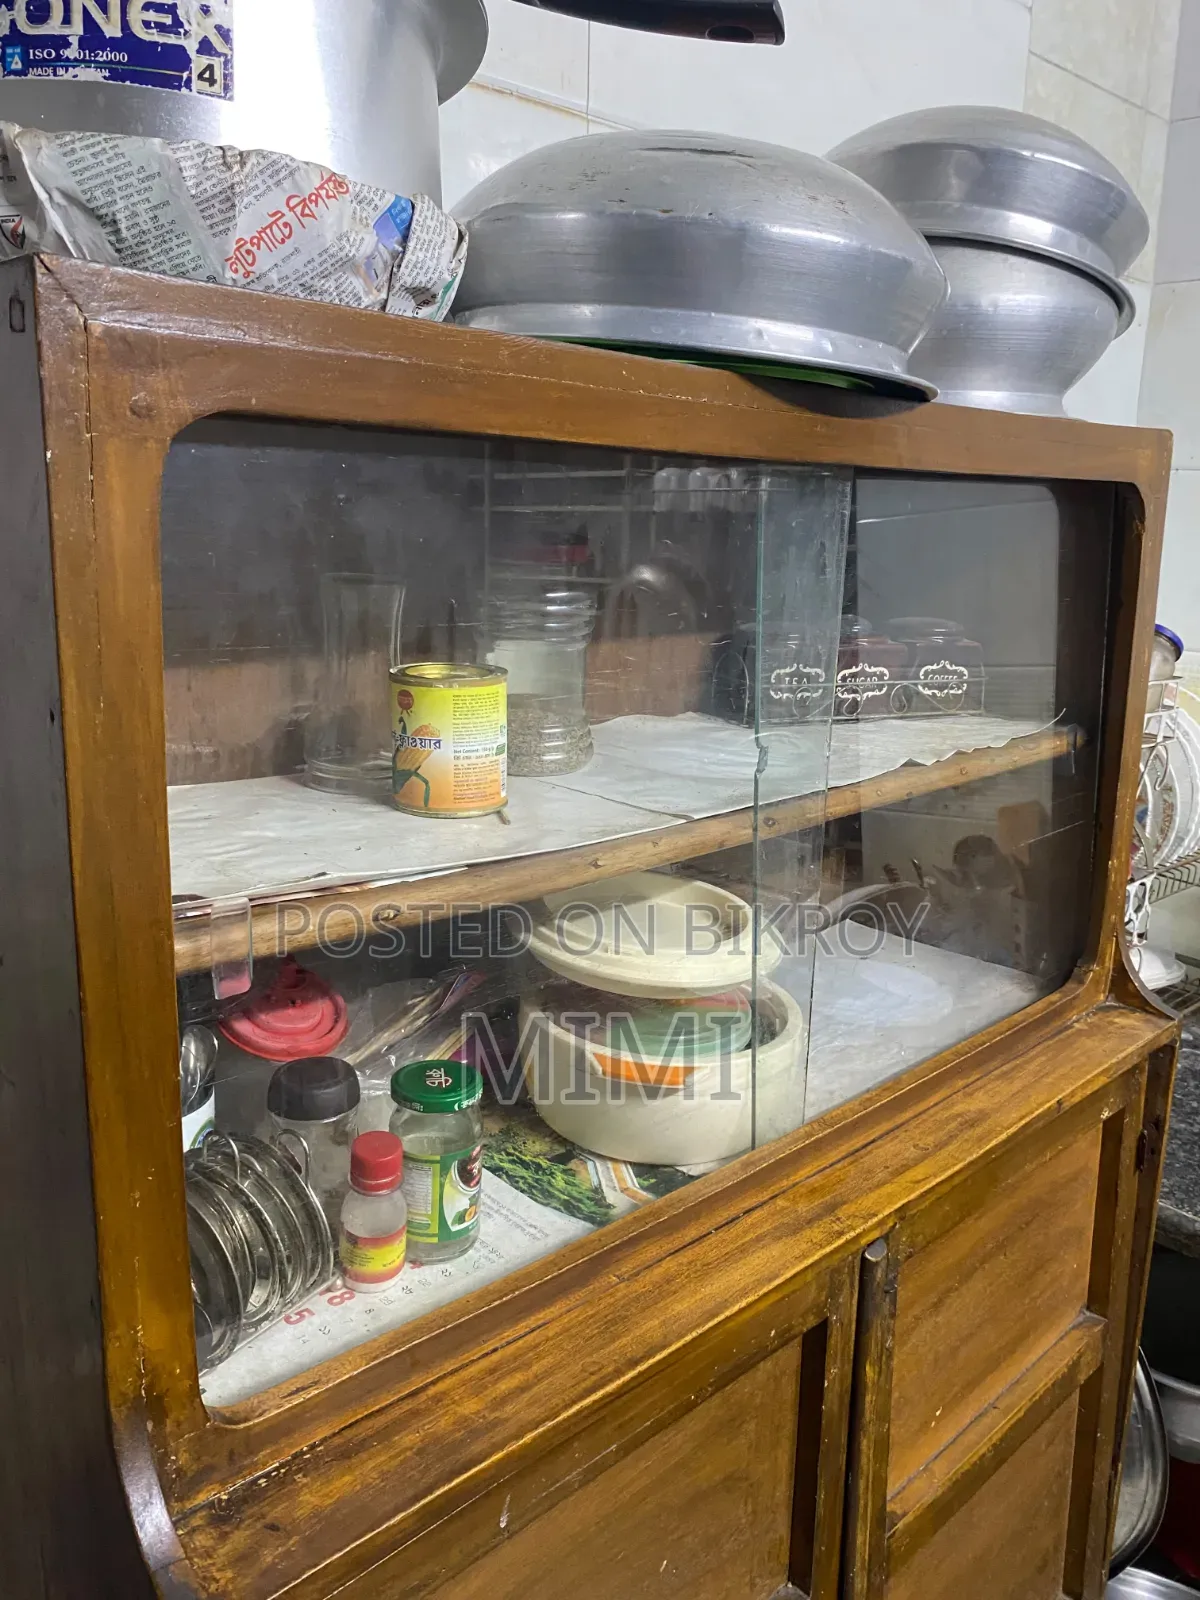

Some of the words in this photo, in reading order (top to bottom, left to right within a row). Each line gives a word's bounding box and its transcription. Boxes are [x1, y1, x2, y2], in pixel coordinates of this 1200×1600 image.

[0, 0, 232, 55] ONEX
[28, 48, 55, 60] ISO
[28, 67, 54, 76] MADE
[56, 67, 66, 76] IN
[197, 63, 218, 88] 4
[224, 210, 293, 279] লুটপাটে
